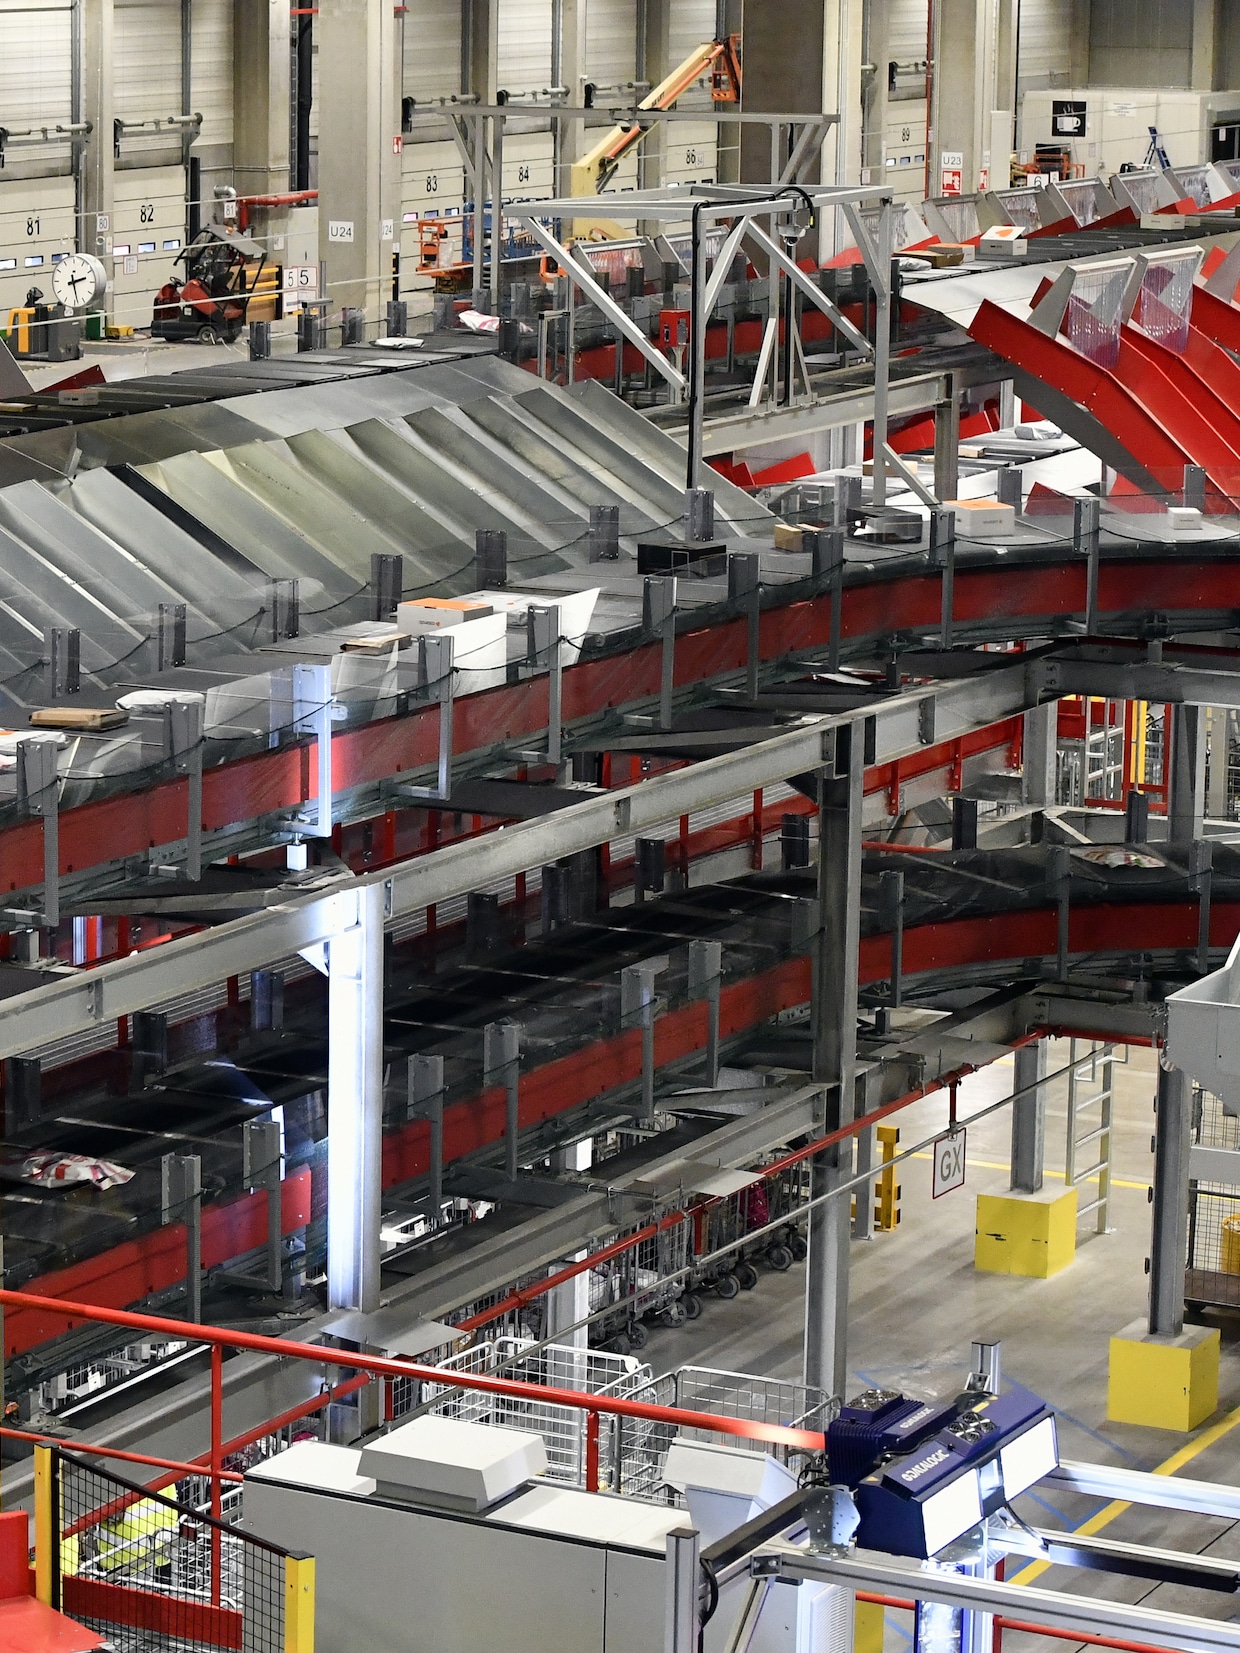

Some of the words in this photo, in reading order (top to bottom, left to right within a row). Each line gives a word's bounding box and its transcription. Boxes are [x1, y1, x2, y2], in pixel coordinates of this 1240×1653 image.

[686, 149, 696, 164] 86
[943, 157, 962, 165] U23
[518, 166, 529, 182] 84
[426, 175, 438, 192] 83
[140, 204, 154, 223] 82
[226, 205, 236, 216] 81
[26, 216, 40, 236] 81
[98, 218, 108, 230] 80
[330, 226, 352, 237] U24
[288, 271, 294, 287] 5
[299, 269, 309, 286] 5
[941, 1143, 962, 1181] GX
[903, 1449, 950, 1481] DATALOGIC
